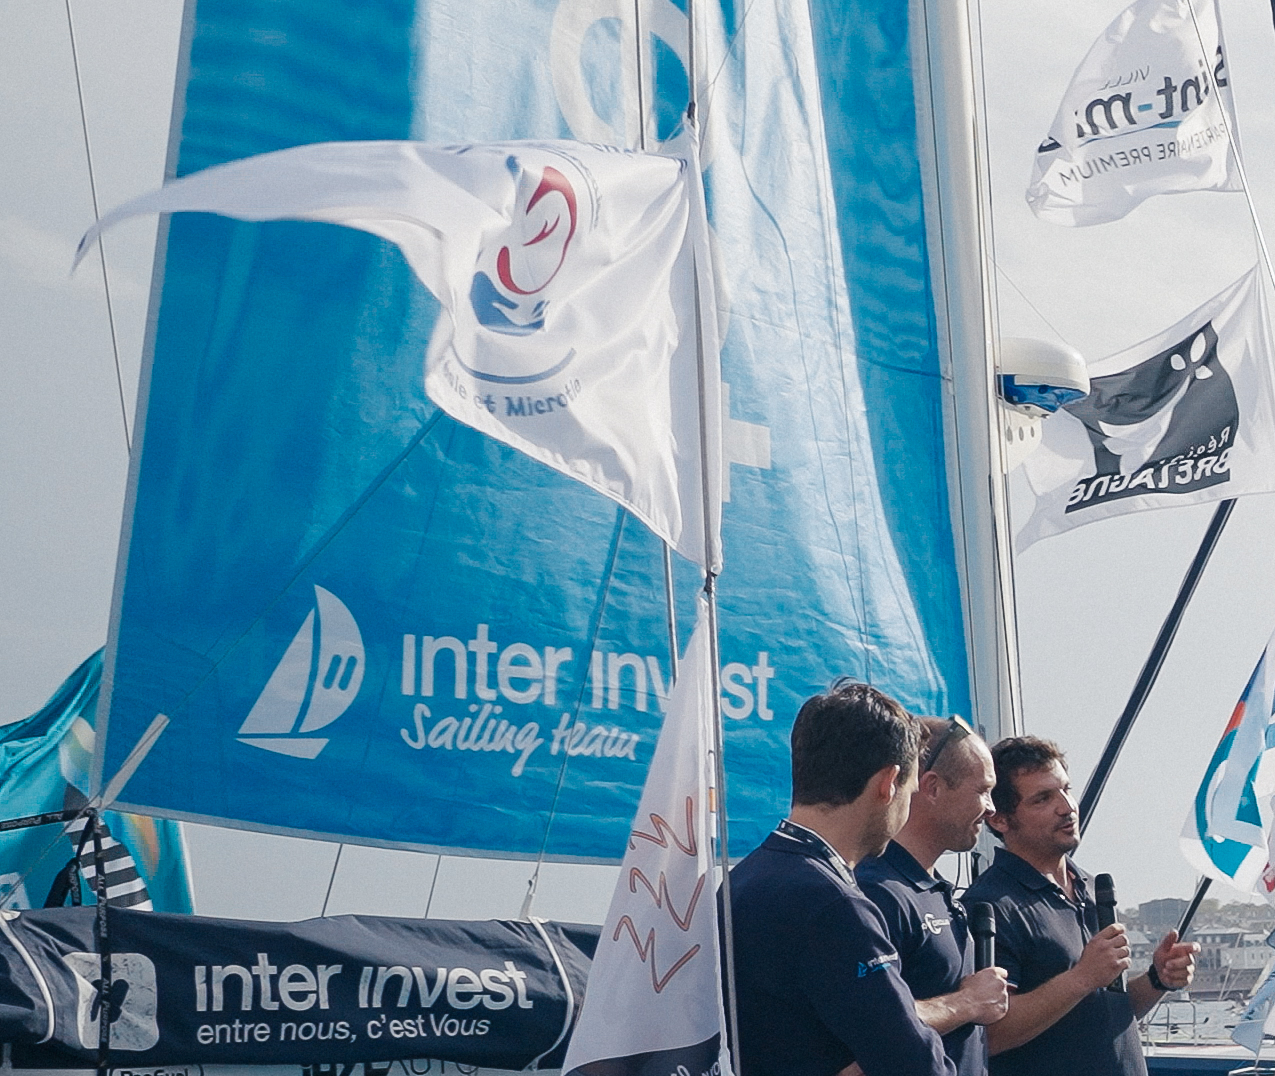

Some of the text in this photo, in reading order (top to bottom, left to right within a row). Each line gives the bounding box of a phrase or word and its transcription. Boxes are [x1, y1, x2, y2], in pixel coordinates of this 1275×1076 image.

[402, 623, 775, 722] inter invst
[401, 702, 642, 778] Sailing team
[195, 952, 534, 1012] inter invest
[101, 1001, 110, 1044] PURPOSE
[197, 1014, 491, 1045] entre nous, c'est Vous
